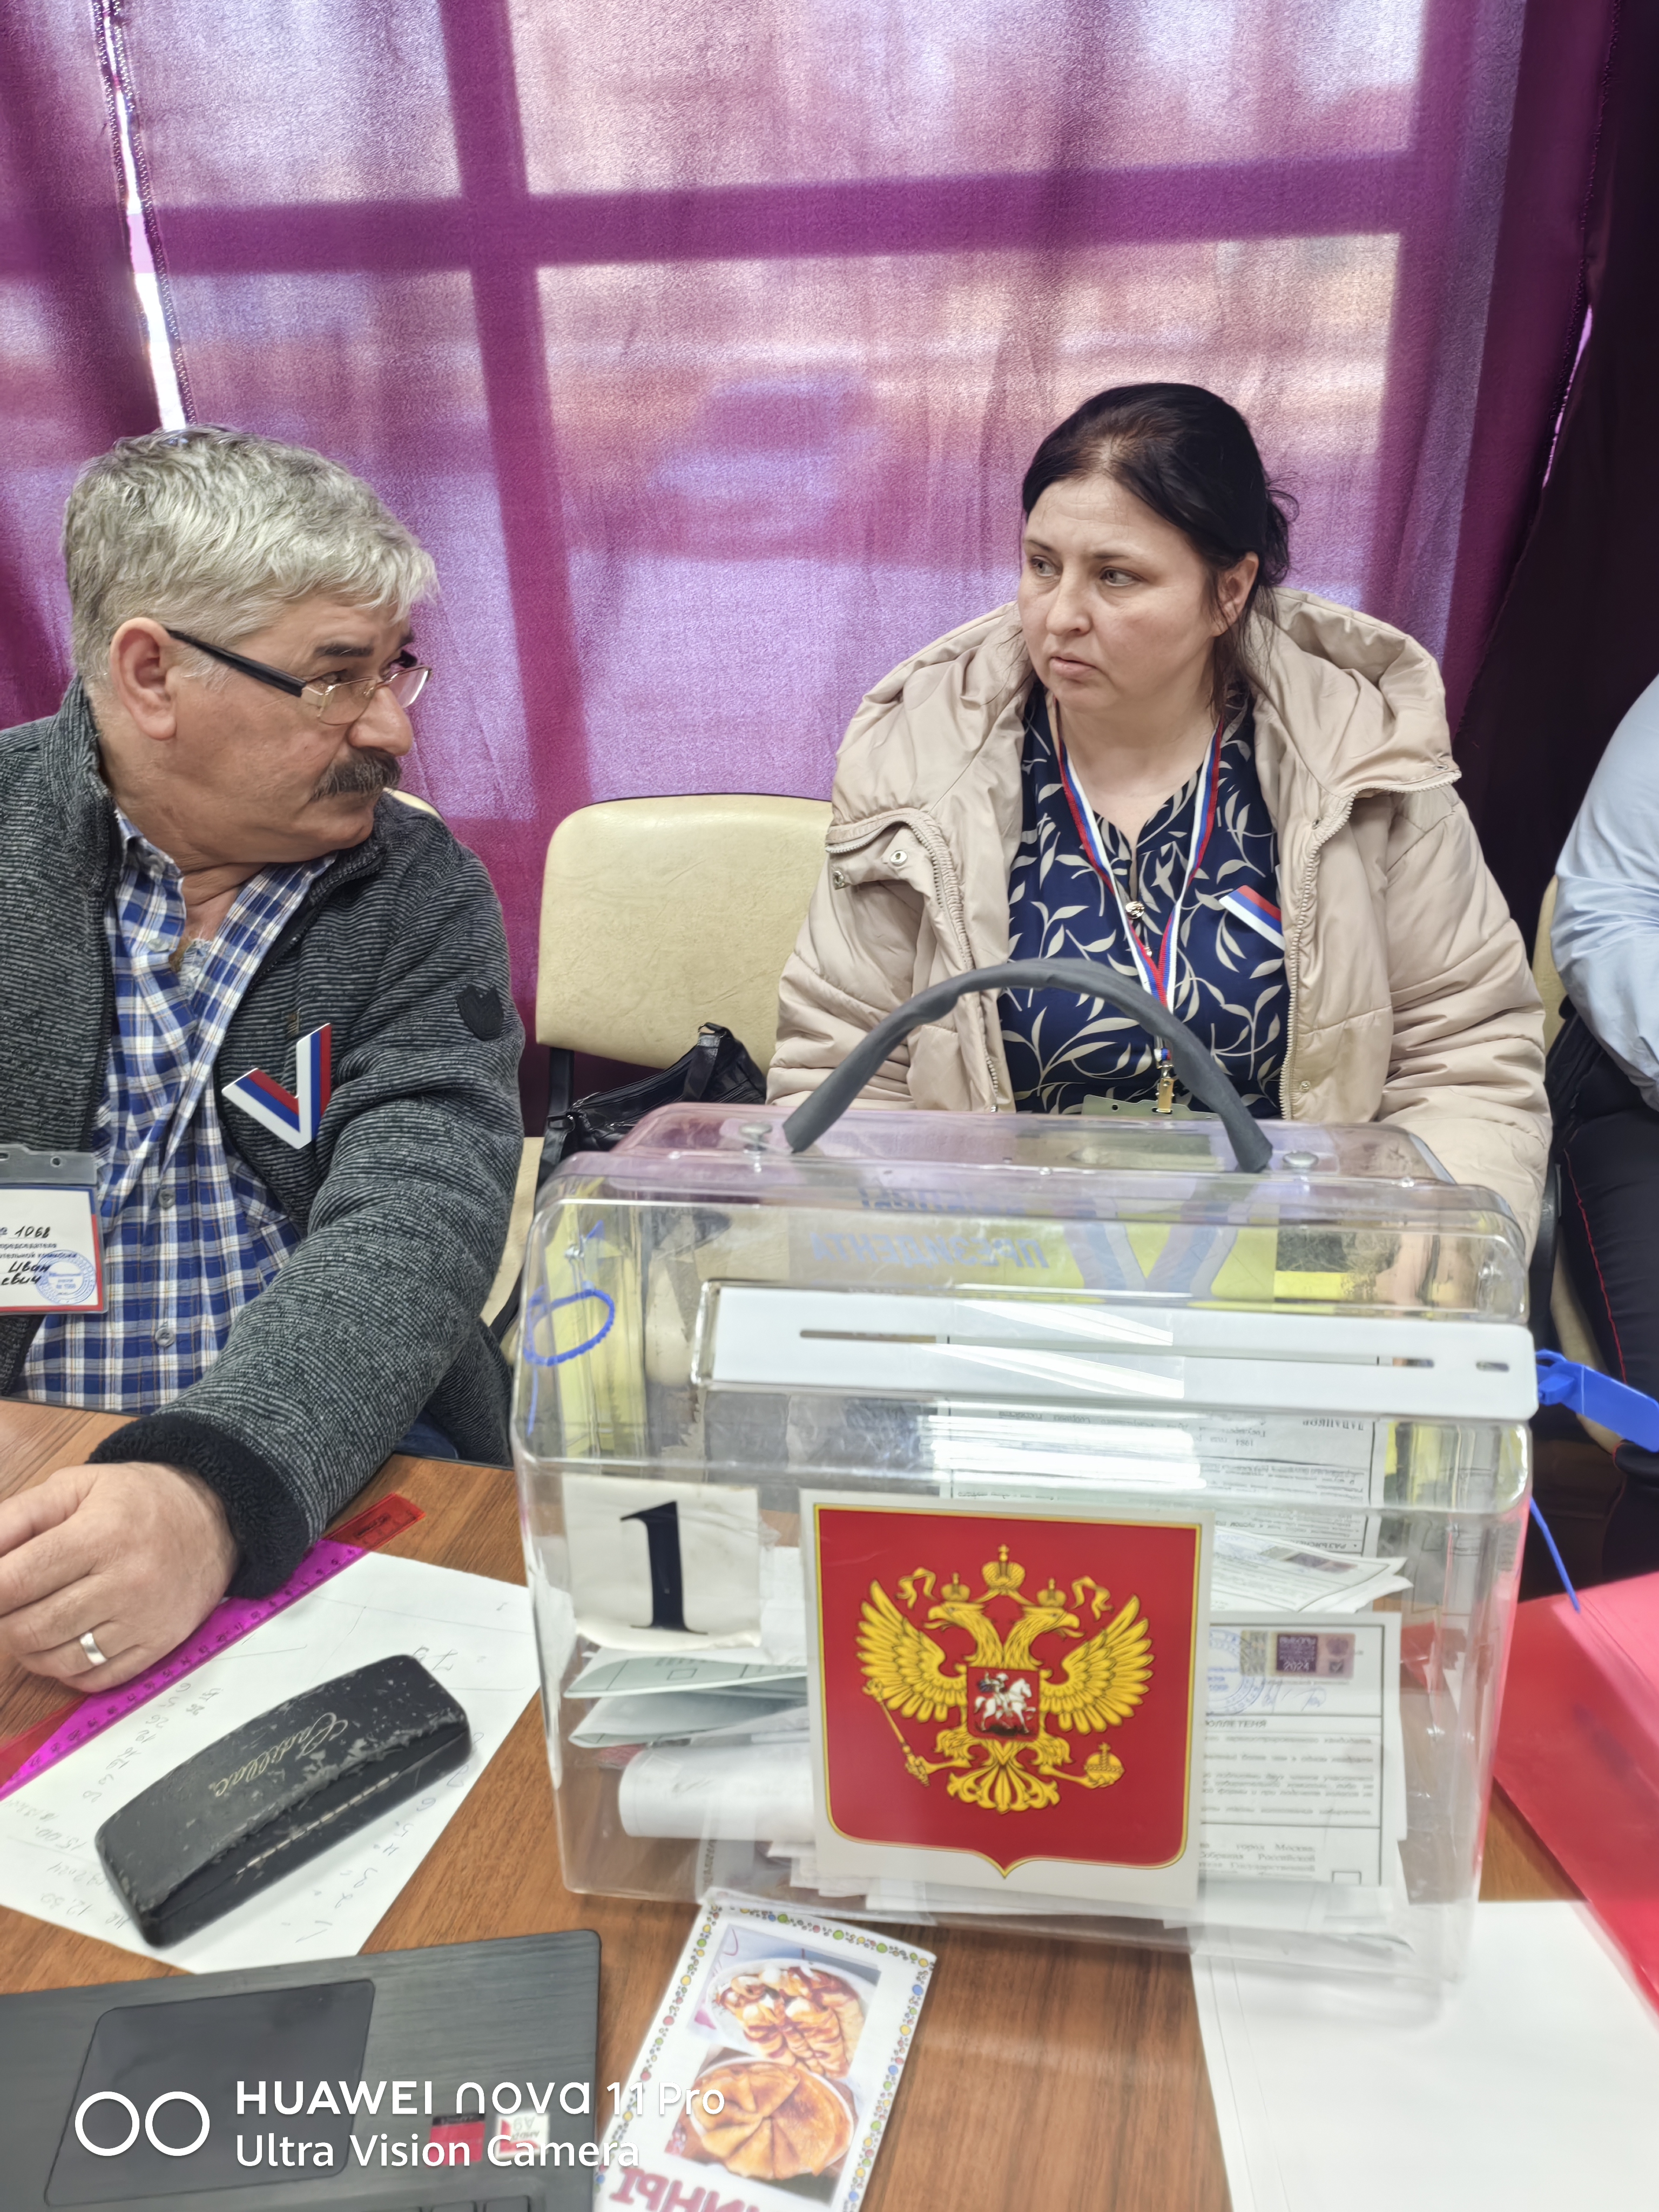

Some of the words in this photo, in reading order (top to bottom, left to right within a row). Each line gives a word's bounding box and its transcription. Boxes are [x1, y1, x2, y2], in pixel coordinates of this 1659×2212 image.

[8, 1260, 51, 1273] Иван
[1, 1272, 42, 1285] евич
[620, 1501, 708, 1635] 1
[1205, 1719, 1267, 1728] ЮЛЛЕТЕНЯ
